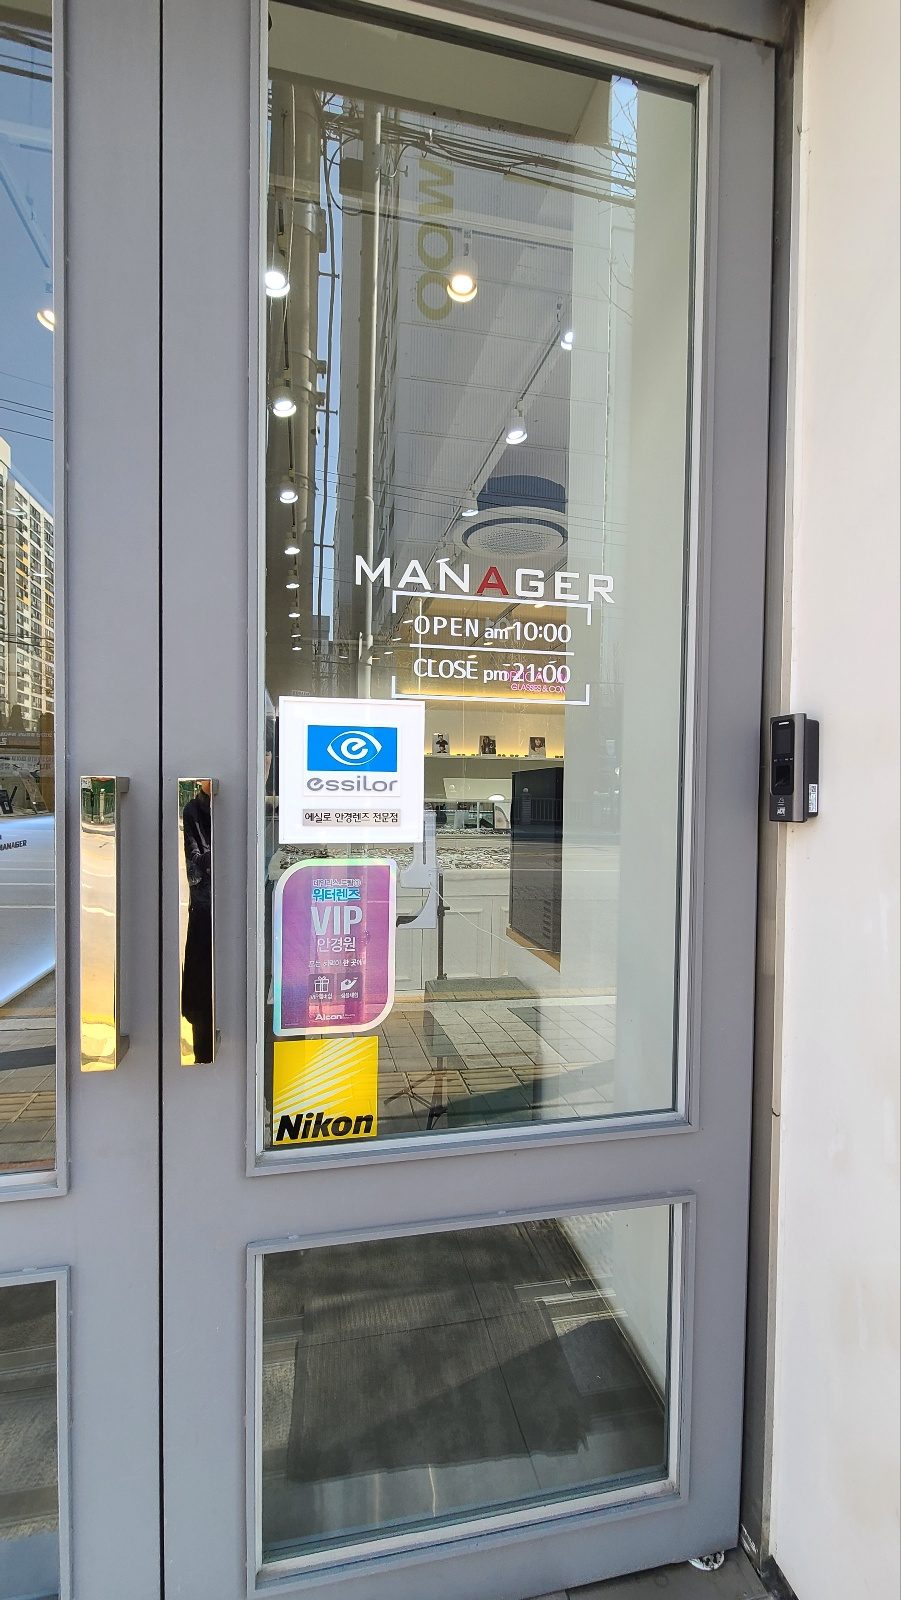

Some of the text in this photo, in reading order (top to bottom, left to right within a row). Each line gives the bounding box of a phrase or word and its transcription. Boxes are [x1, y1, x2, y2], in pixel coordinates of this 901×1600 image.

[355, 554, 615, 604] MANAGER
[413, 615, 572, 643] OPEN am 10:00
[413, 658, 571, 684] CLOSE pm 21:00
[306, 775, 398, 792] essilor
[304, 812, 398, 824] 에실로 안경렌즈 전문점
[312, 888, 361, 902] 워터렌즈
[310, 905, 363, 936] VIP
[317, 937, 356, 953] 안경원
[314, 1013, 342, 1021] Alcon
[276, 1112, 374, 1141] Nikon
